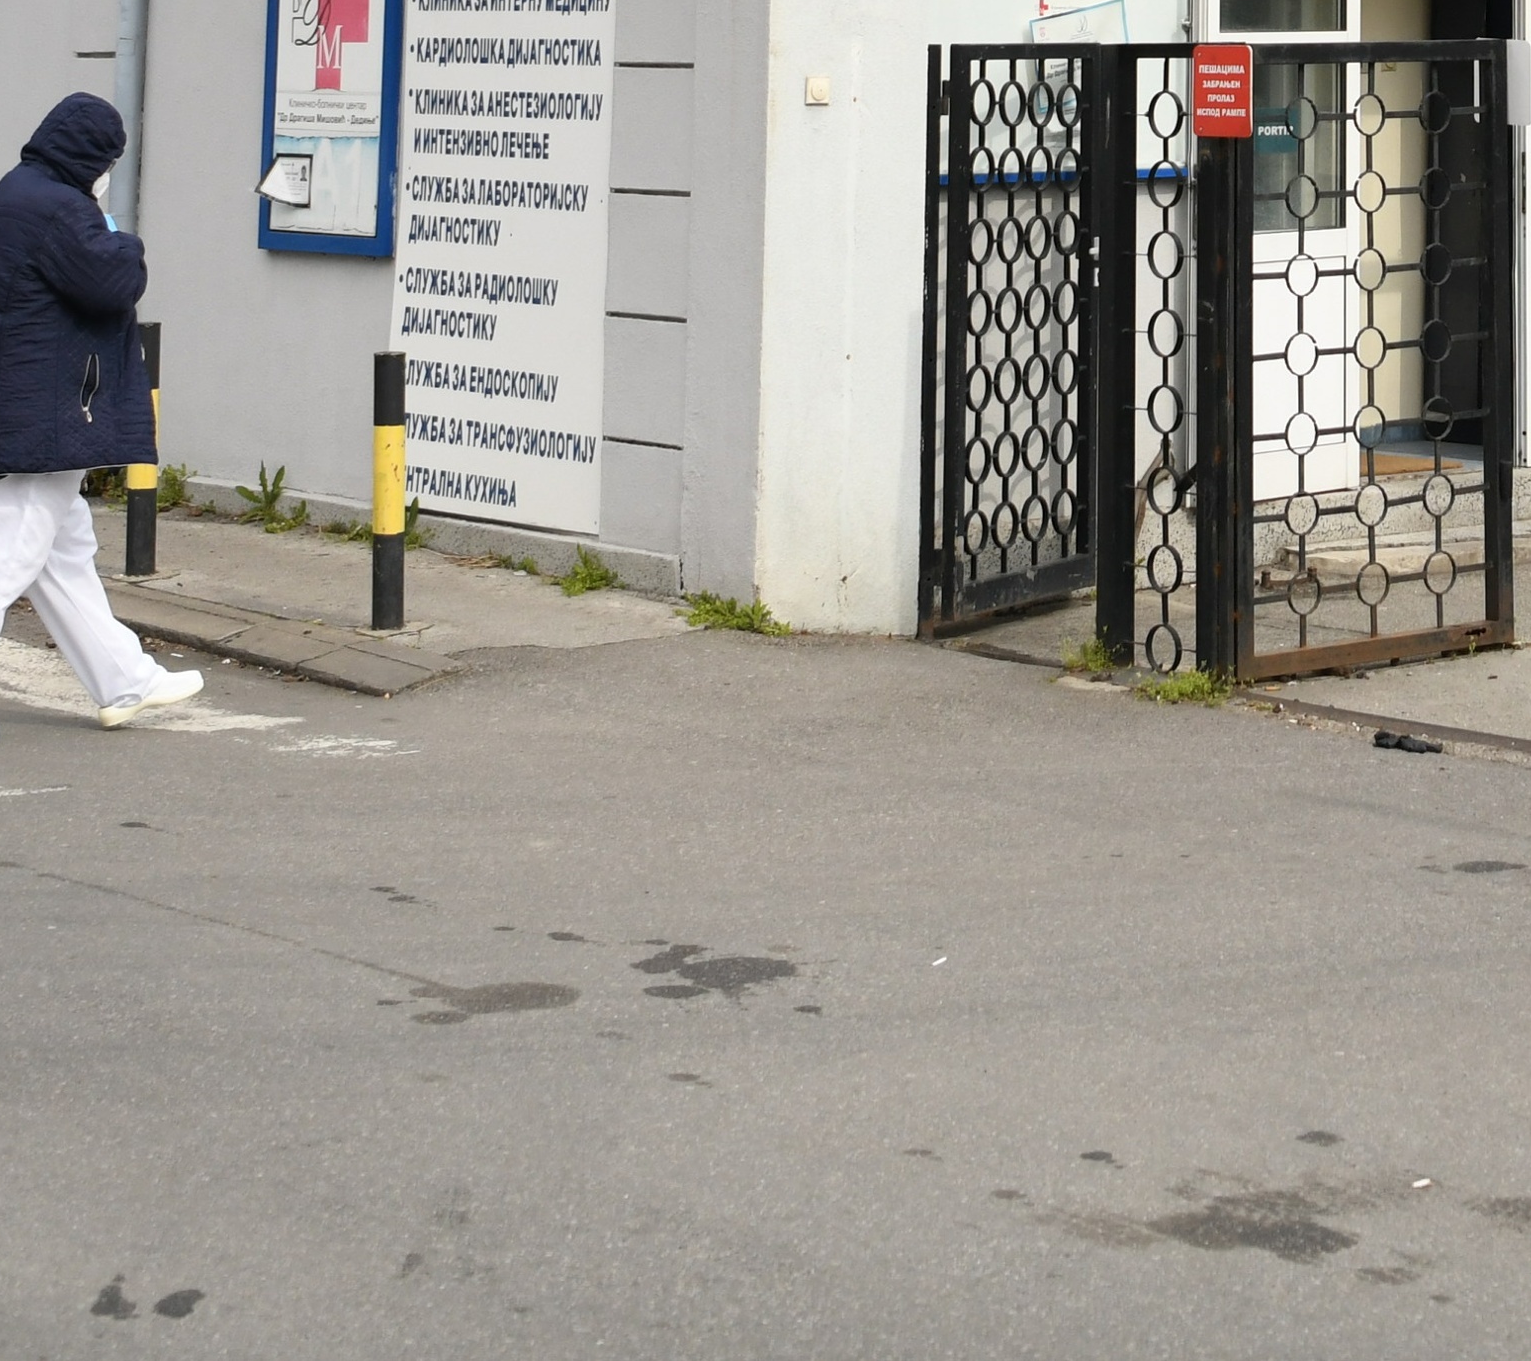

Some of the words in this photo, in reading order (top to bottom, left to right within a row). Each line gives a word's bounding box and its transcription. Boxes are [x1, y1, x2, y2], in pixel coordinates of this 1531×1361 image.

[317, 25, 344, 69] M
[417, 37, 505, 67] КАРДИОЛОШКА
[507, 39, 601, 68] ДИЈАГНОСТИКА
[1199, 65, 1245, 75] ПЕШАЦИМА
[1202, 80, 1240, 88] ЗАБРАЊЕН
[415, 89, 469, 116] КЛИНИКА
[471, 90, 485, 117] ЗА
[487, 91, 603, 121] АНЕСТЕЗИОЛОГИЈУ
[1197, 108, 1221, 117] ИСПОД
[1221, 109, 1246, 117] РАМПЕ
[1207, 94, 1235, 102] ПРОЛАЗ
[414, 128, 421, 153] И
[423, 128, 499, 157] ИНТЕНЗИВНО
[500, 131, 550, 160] ЛЕЧЕЊЕ
[412, 175, 459, 203] СЛУЖБА
[461, 178, 476, 204] ЗА
[477, 179, 589, 212] ЛАБОРАТОРИЈСКУ
[408, 214, 501, 246] ДИЈАГНОСТИКУ
[405, 267, 455, 297] СЛУЖБА
[457, 271, 472, 298] ЗА
[474, 272, 559, 307] РАДИОЛОШКУ
[401, 306, 497, 341] ДИЈАГНОСТИКУ
[405, 359, 450, 390] ЛУЖБА
[452, 364, 467, 393] ЗА
[469, 366, 559, 403] ЕНДОСКОПИЈУ
[405, 412, 446, 444] ЛУЖБА
[448, 417, 463, 445] ЗА
[466, 420, 596, 464] ТРАНСФУЗИОЛОГИЈУ
[405, 465, 462, 499] НТРАЛНА
[464, 474, 517, 508] КУХИЊА
